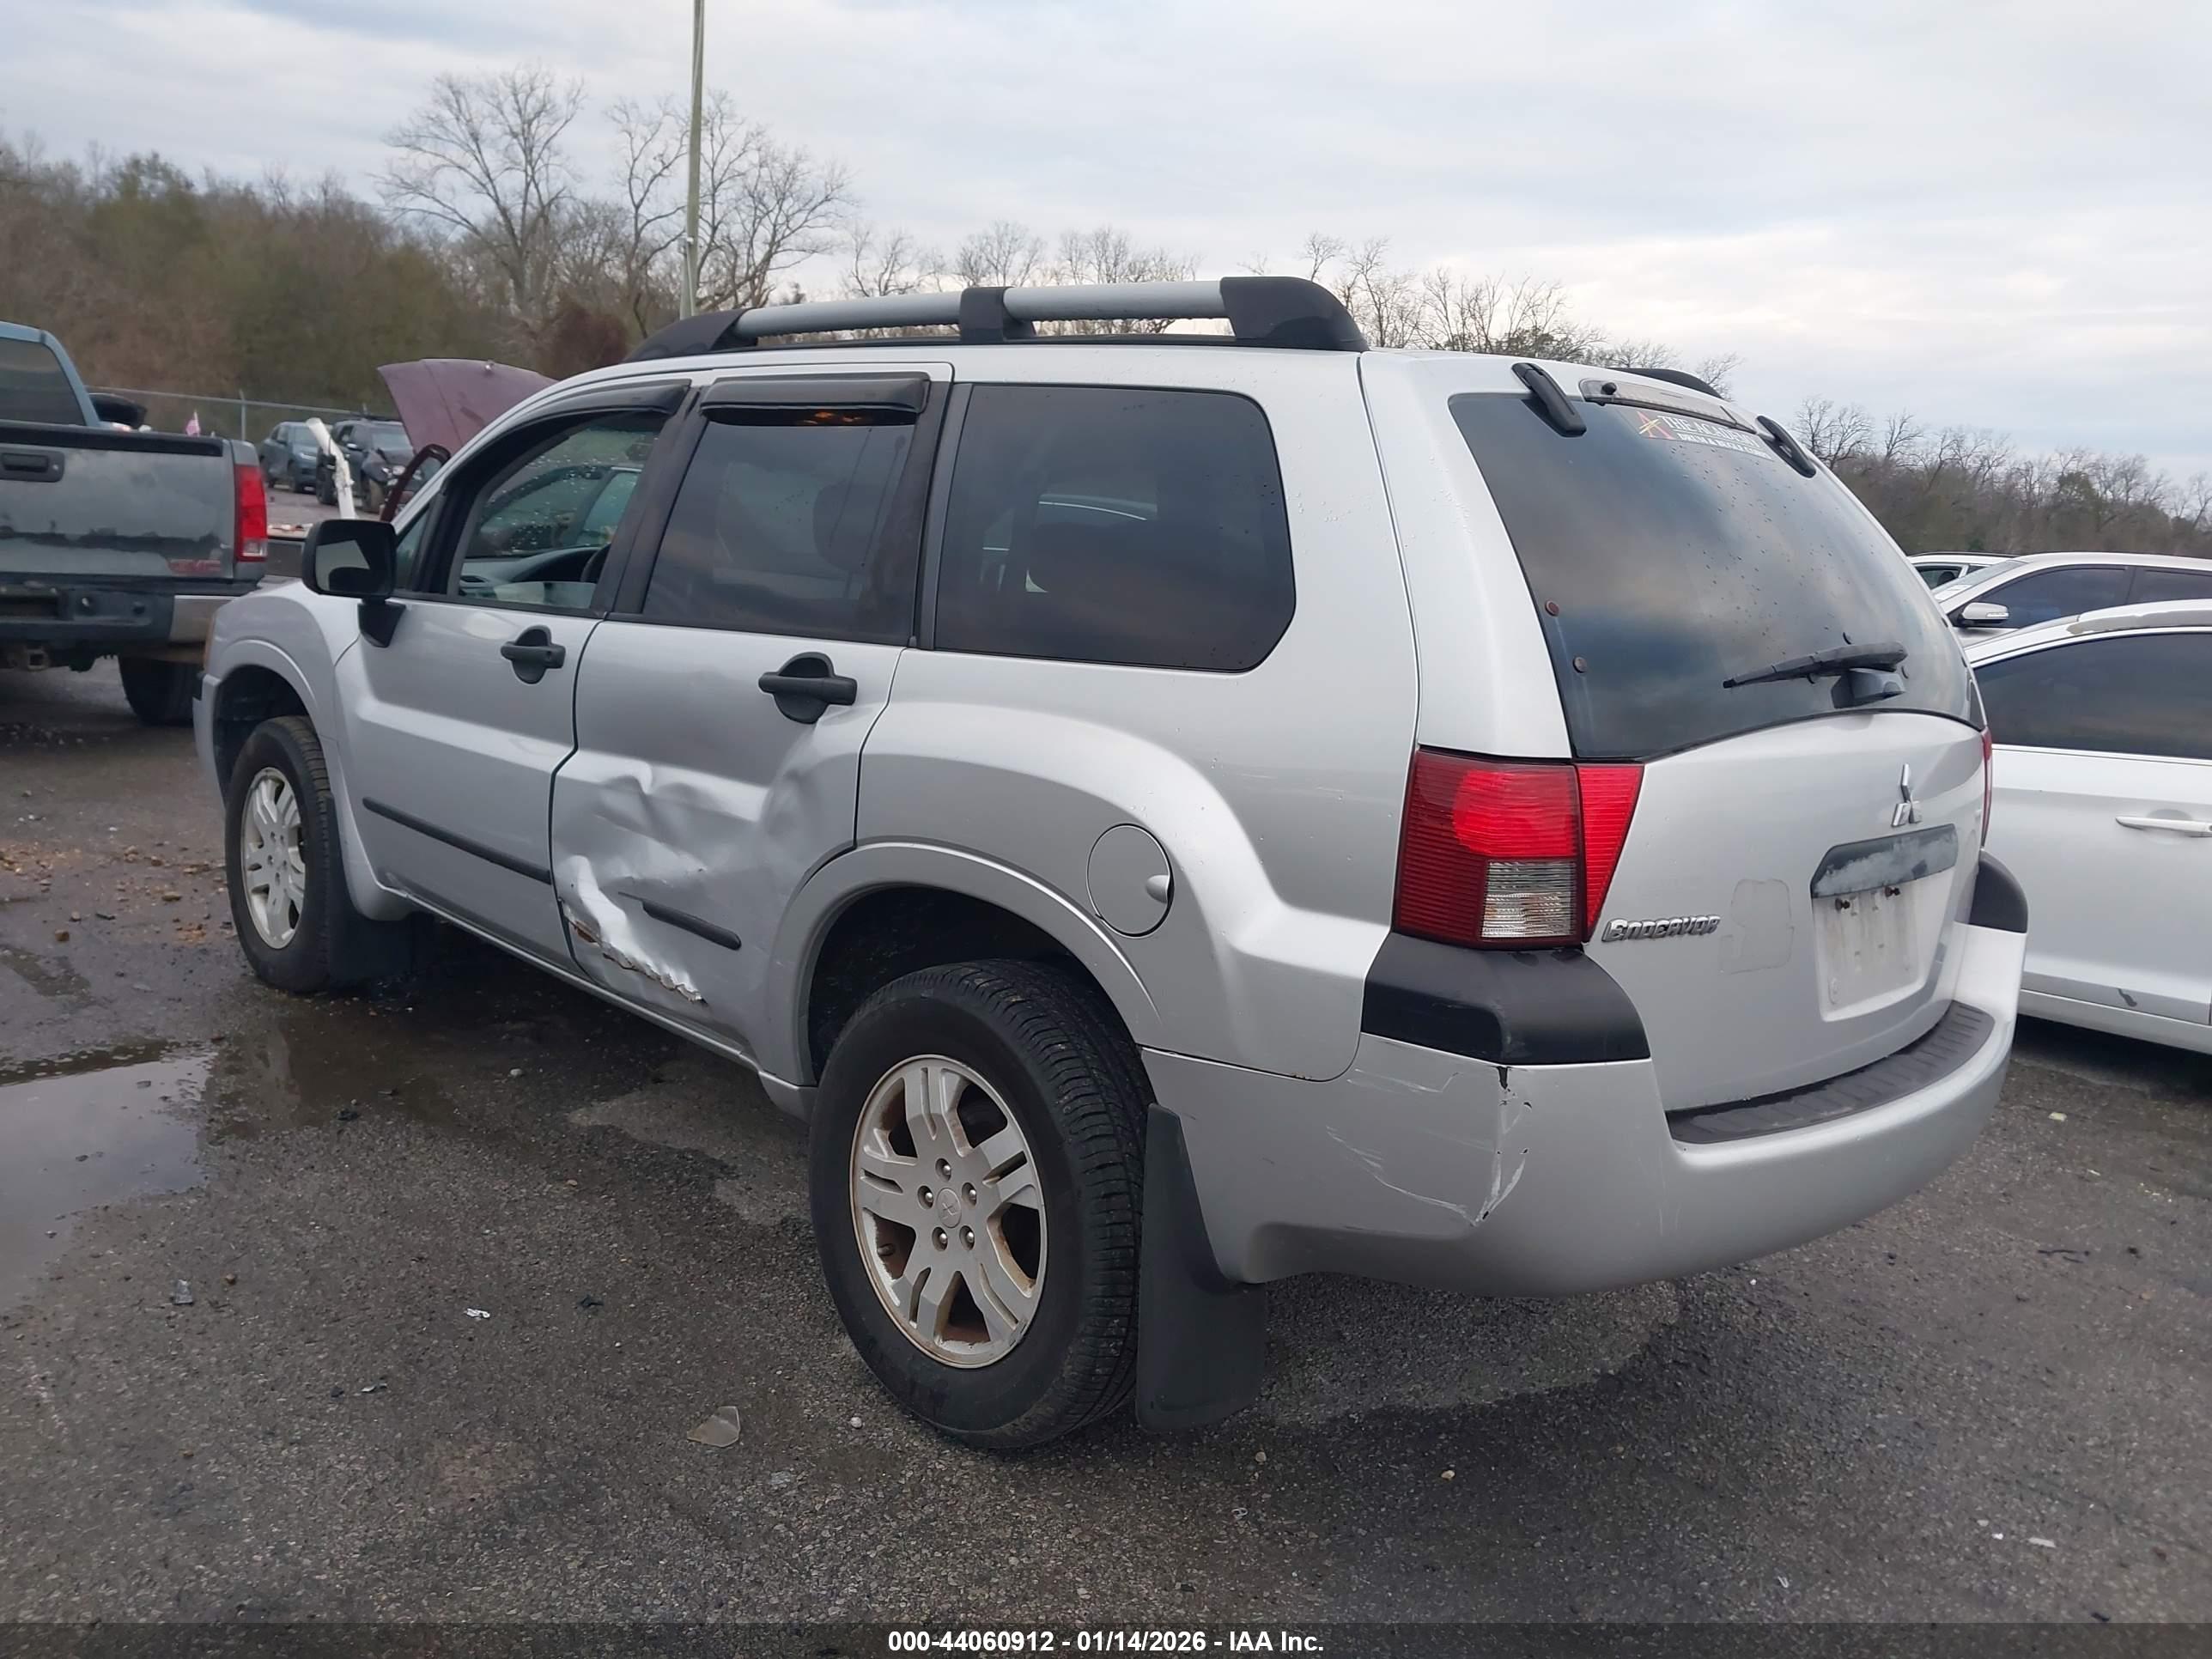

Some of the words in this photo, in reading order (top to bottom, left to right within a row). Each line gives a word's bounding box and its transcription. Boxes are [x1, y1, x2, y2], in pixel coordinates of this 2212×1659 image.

[1657, 415, 1696, 432] THE
[1695, 421, 1760, 448] ACADEMY
[1601, 915, 1721, 942] ENDEAVOR
